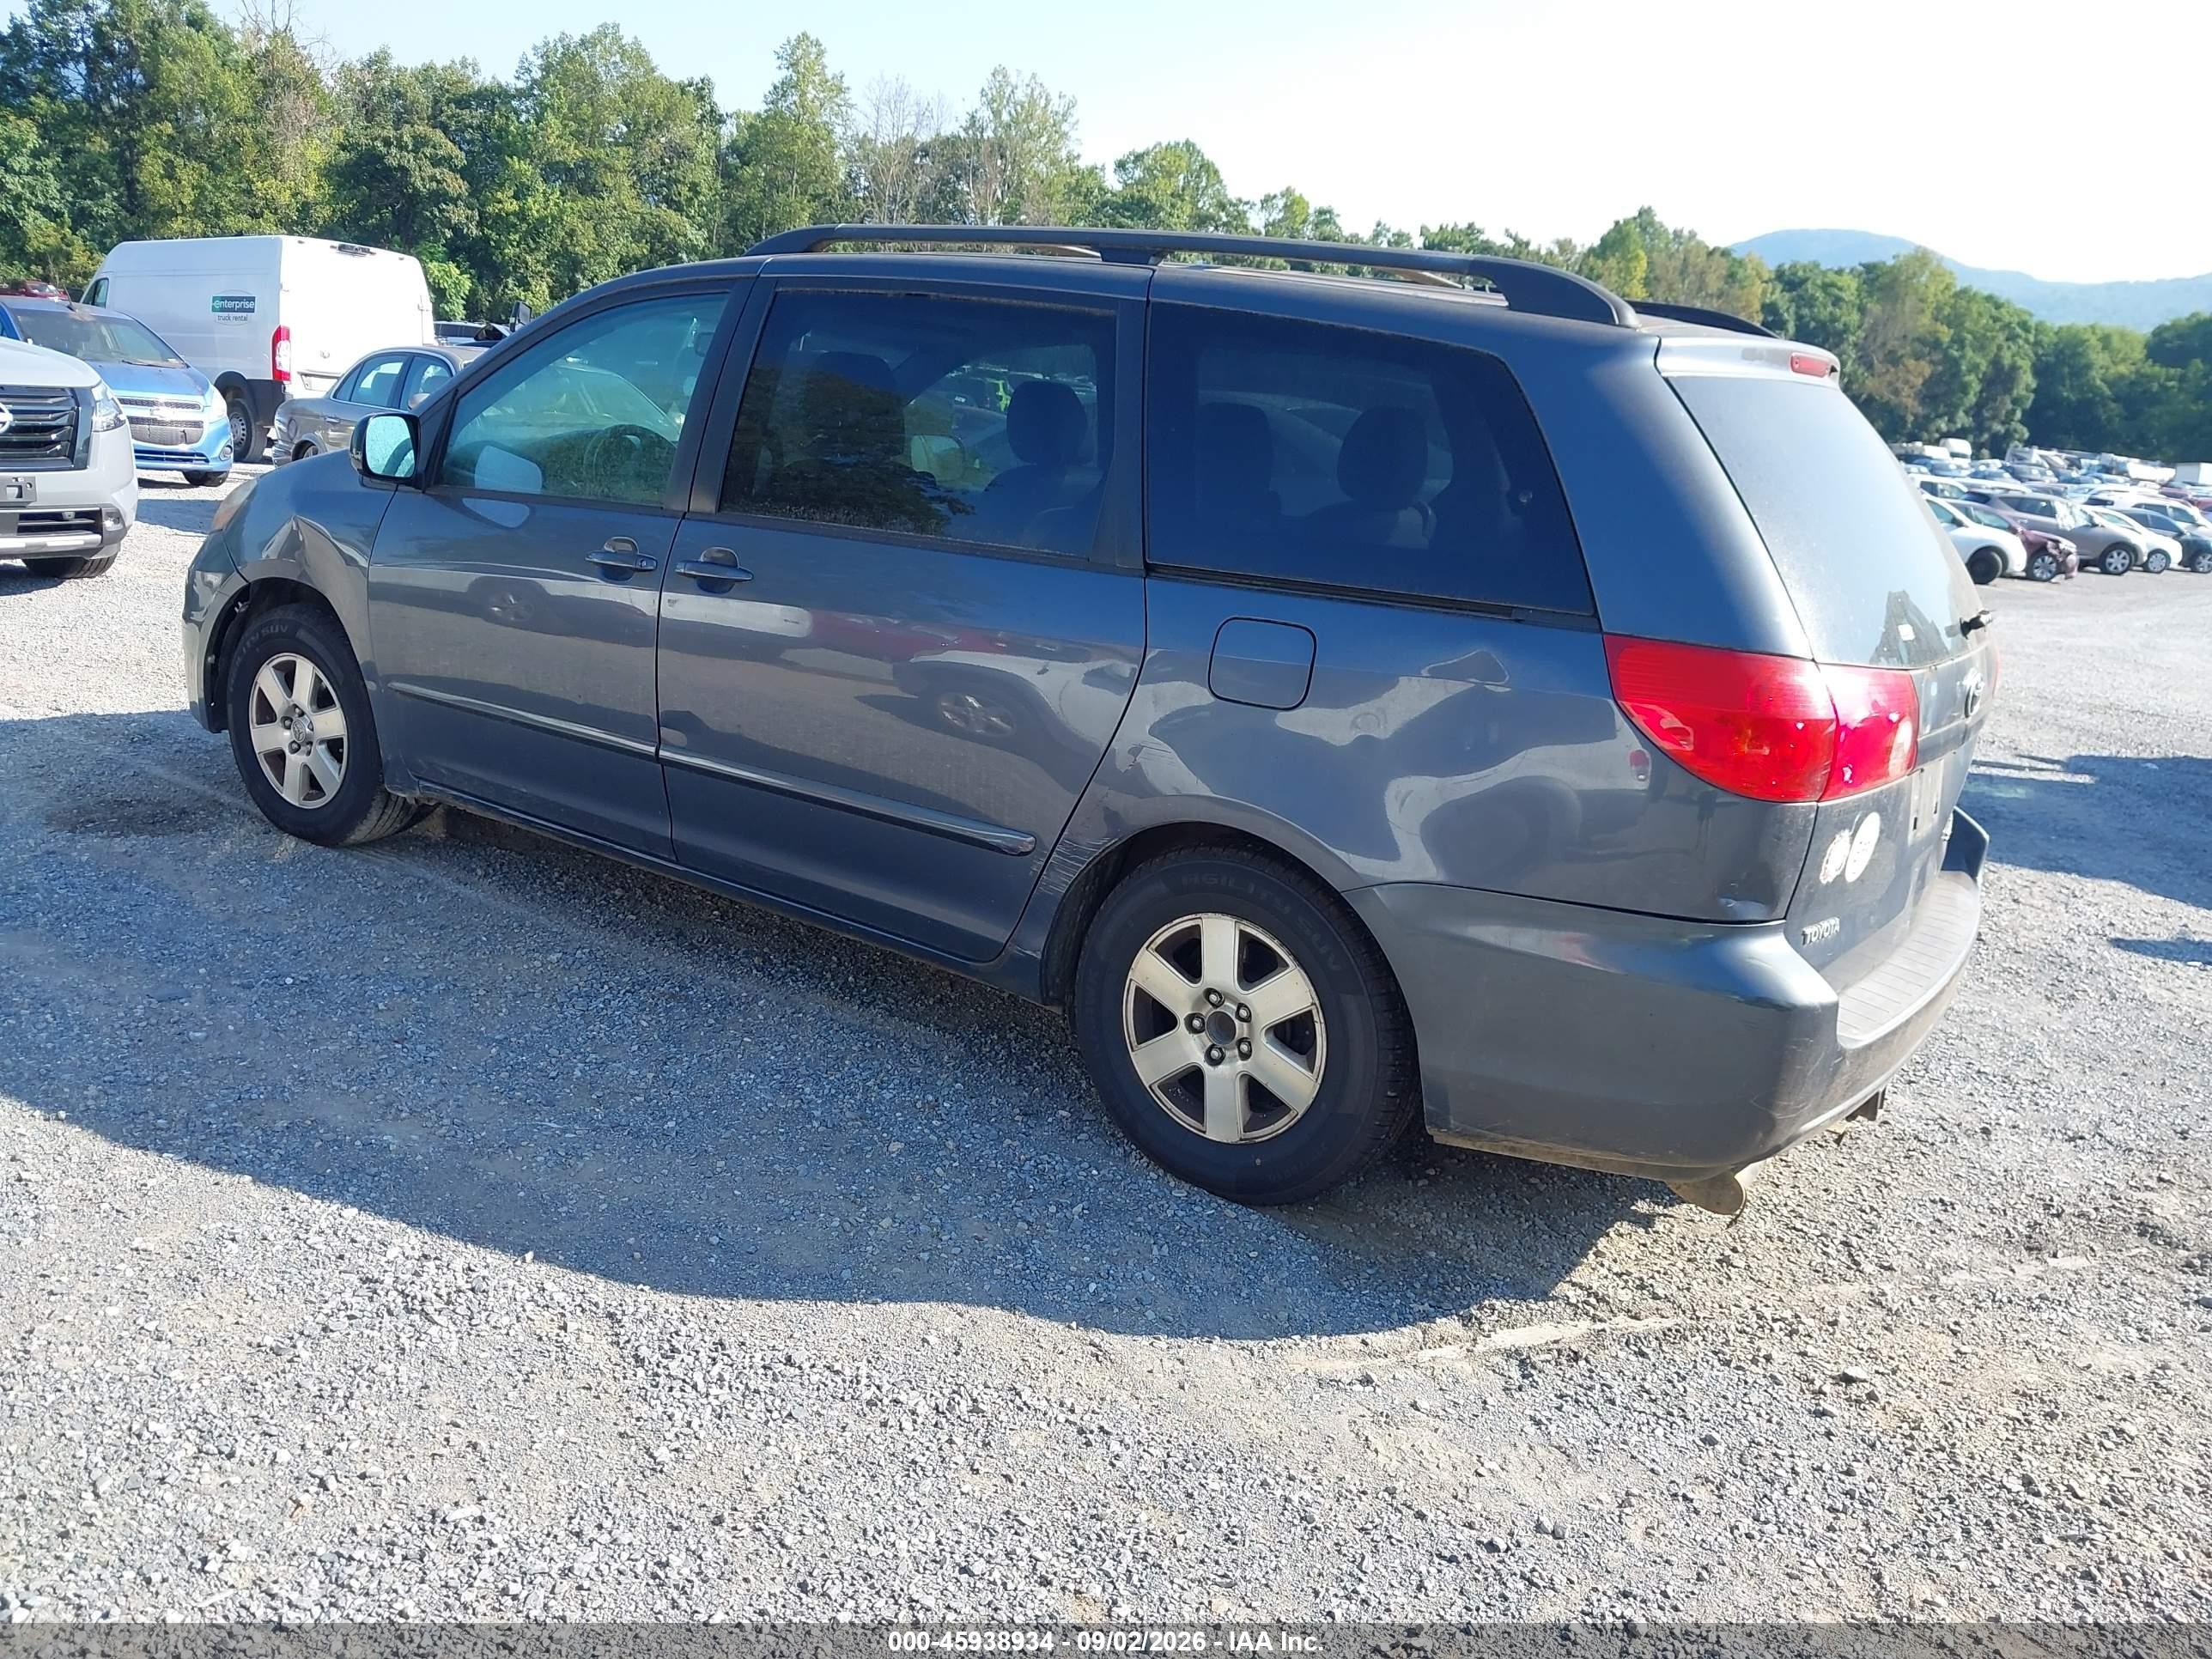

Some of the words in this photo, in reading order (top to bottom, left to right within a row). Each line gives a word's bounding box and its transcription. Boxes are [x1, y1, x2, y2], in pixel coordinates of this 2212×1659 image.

[214, 299, 255, 311] enterprise
[233, 313, 248, 322] rental
[1802, 917, 1840, 945] TOYOTA
